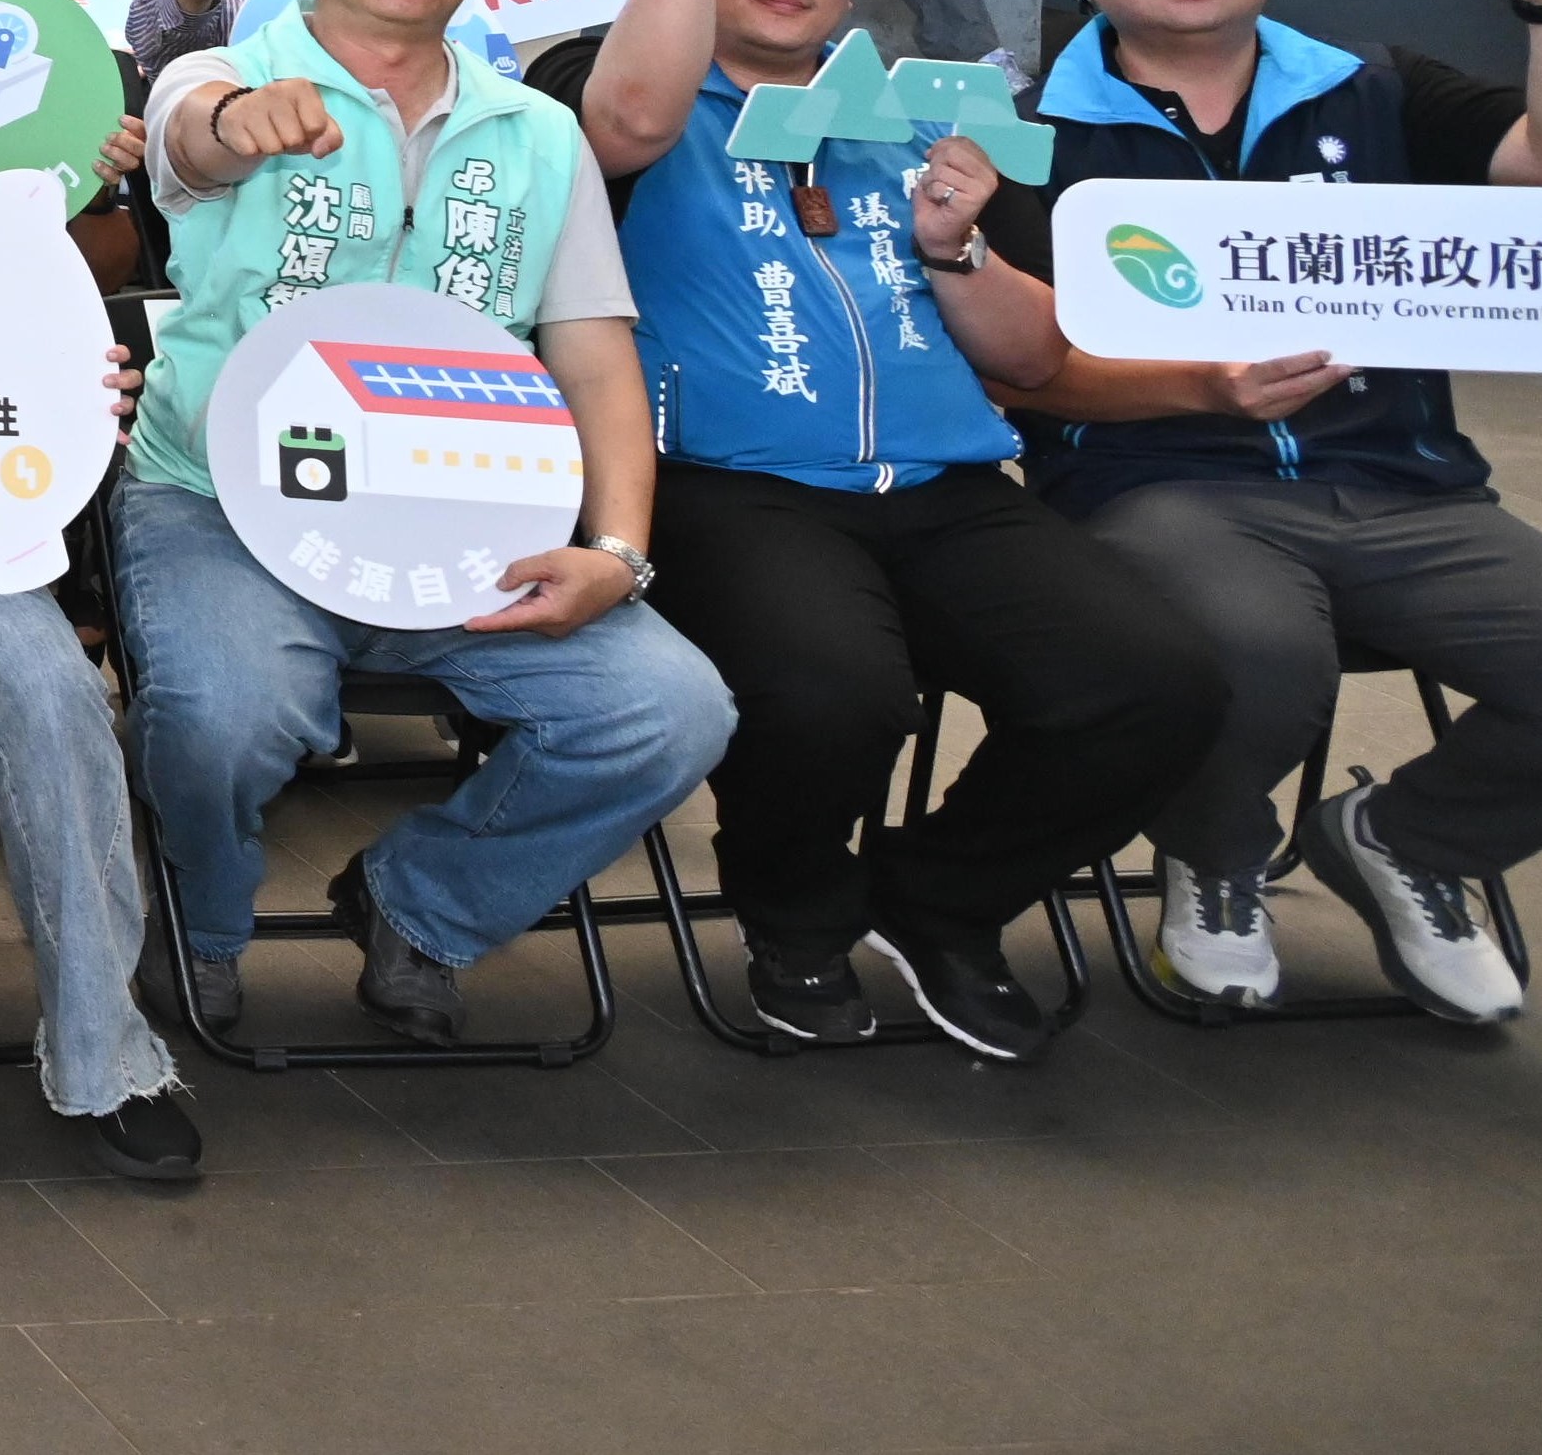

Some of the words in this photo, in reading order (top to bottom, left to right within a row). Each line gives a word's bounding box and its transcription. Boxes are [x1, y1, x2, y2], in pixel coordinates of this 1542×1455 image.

[347, 182, 375, 241] 顧問
[1219, 230, 1542, 291] 宜蘭縣政府
[1221, 293, 1286, 314] Yilan
[1295, 295, 1384, 322] County
[1394, 298, 1542, 321] Governmen
[288, 529, 506, 608] 能源自主
